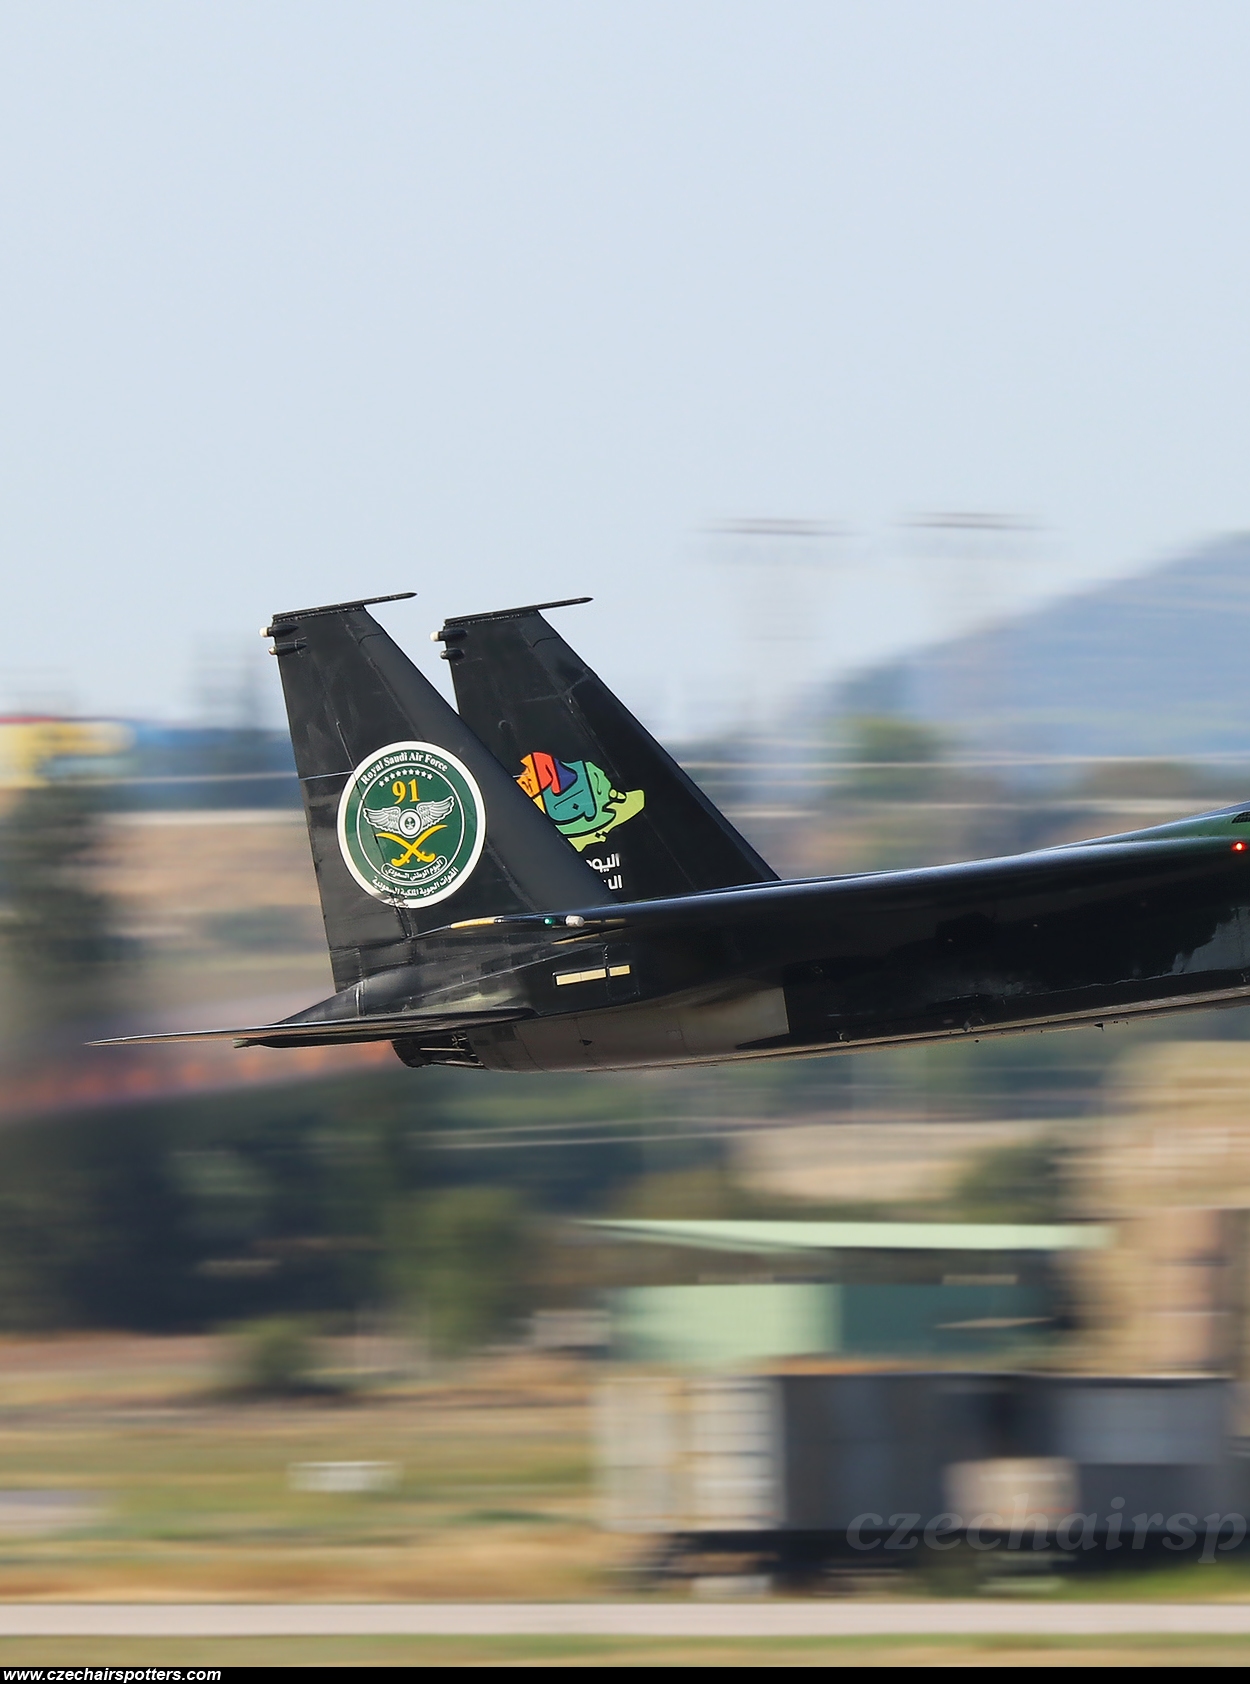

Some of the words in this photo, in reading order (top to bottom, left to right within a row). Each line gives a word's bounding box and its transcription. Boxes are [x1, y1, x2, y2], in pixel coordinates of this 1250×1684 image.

[360, 761, 384, 786] Royal
[384, 752, 408, 767] Saudi
[408, 751, 424, 762] Air
[425, 754, 448, 772] Force
[391, 778, 420, 804] 91
[585, 853, 620, 873] اليو
